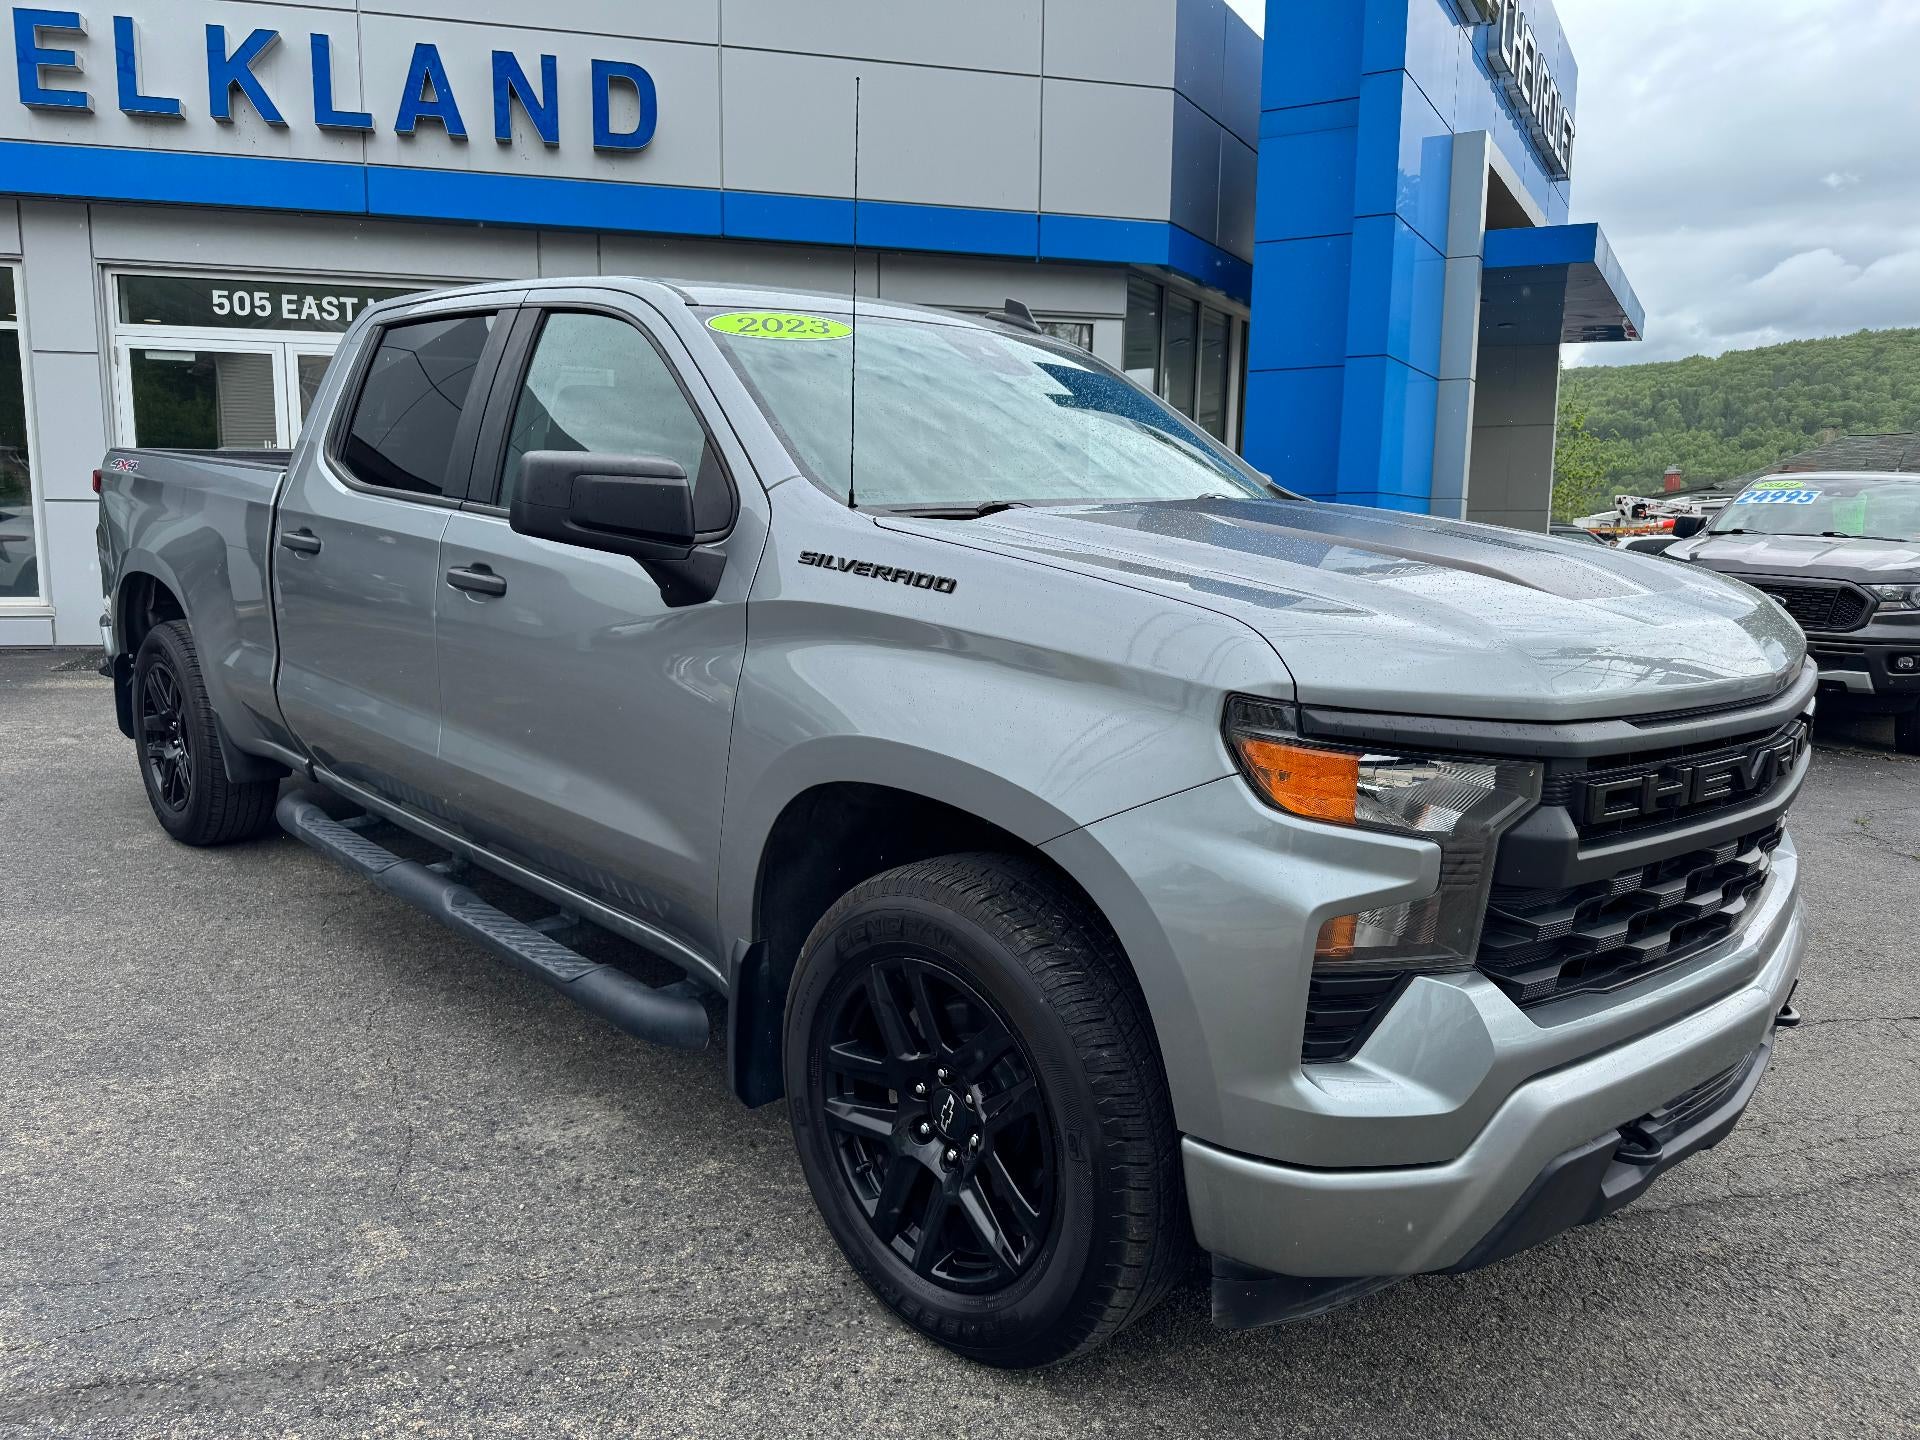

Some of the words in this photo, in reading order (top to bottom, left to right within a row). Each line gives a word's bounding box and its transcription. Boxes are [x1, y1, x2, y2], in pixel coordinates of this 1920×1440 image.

[11, 6, 658, 154] ELKLAND
[211, 289, 273, 317] 505
[281, 293, 359, 322] EAST
[736, 317, 831, 334] 2023
[1736, 490, 1818, 503] 24995
[798, 550, 957, 594] SILVERADO
